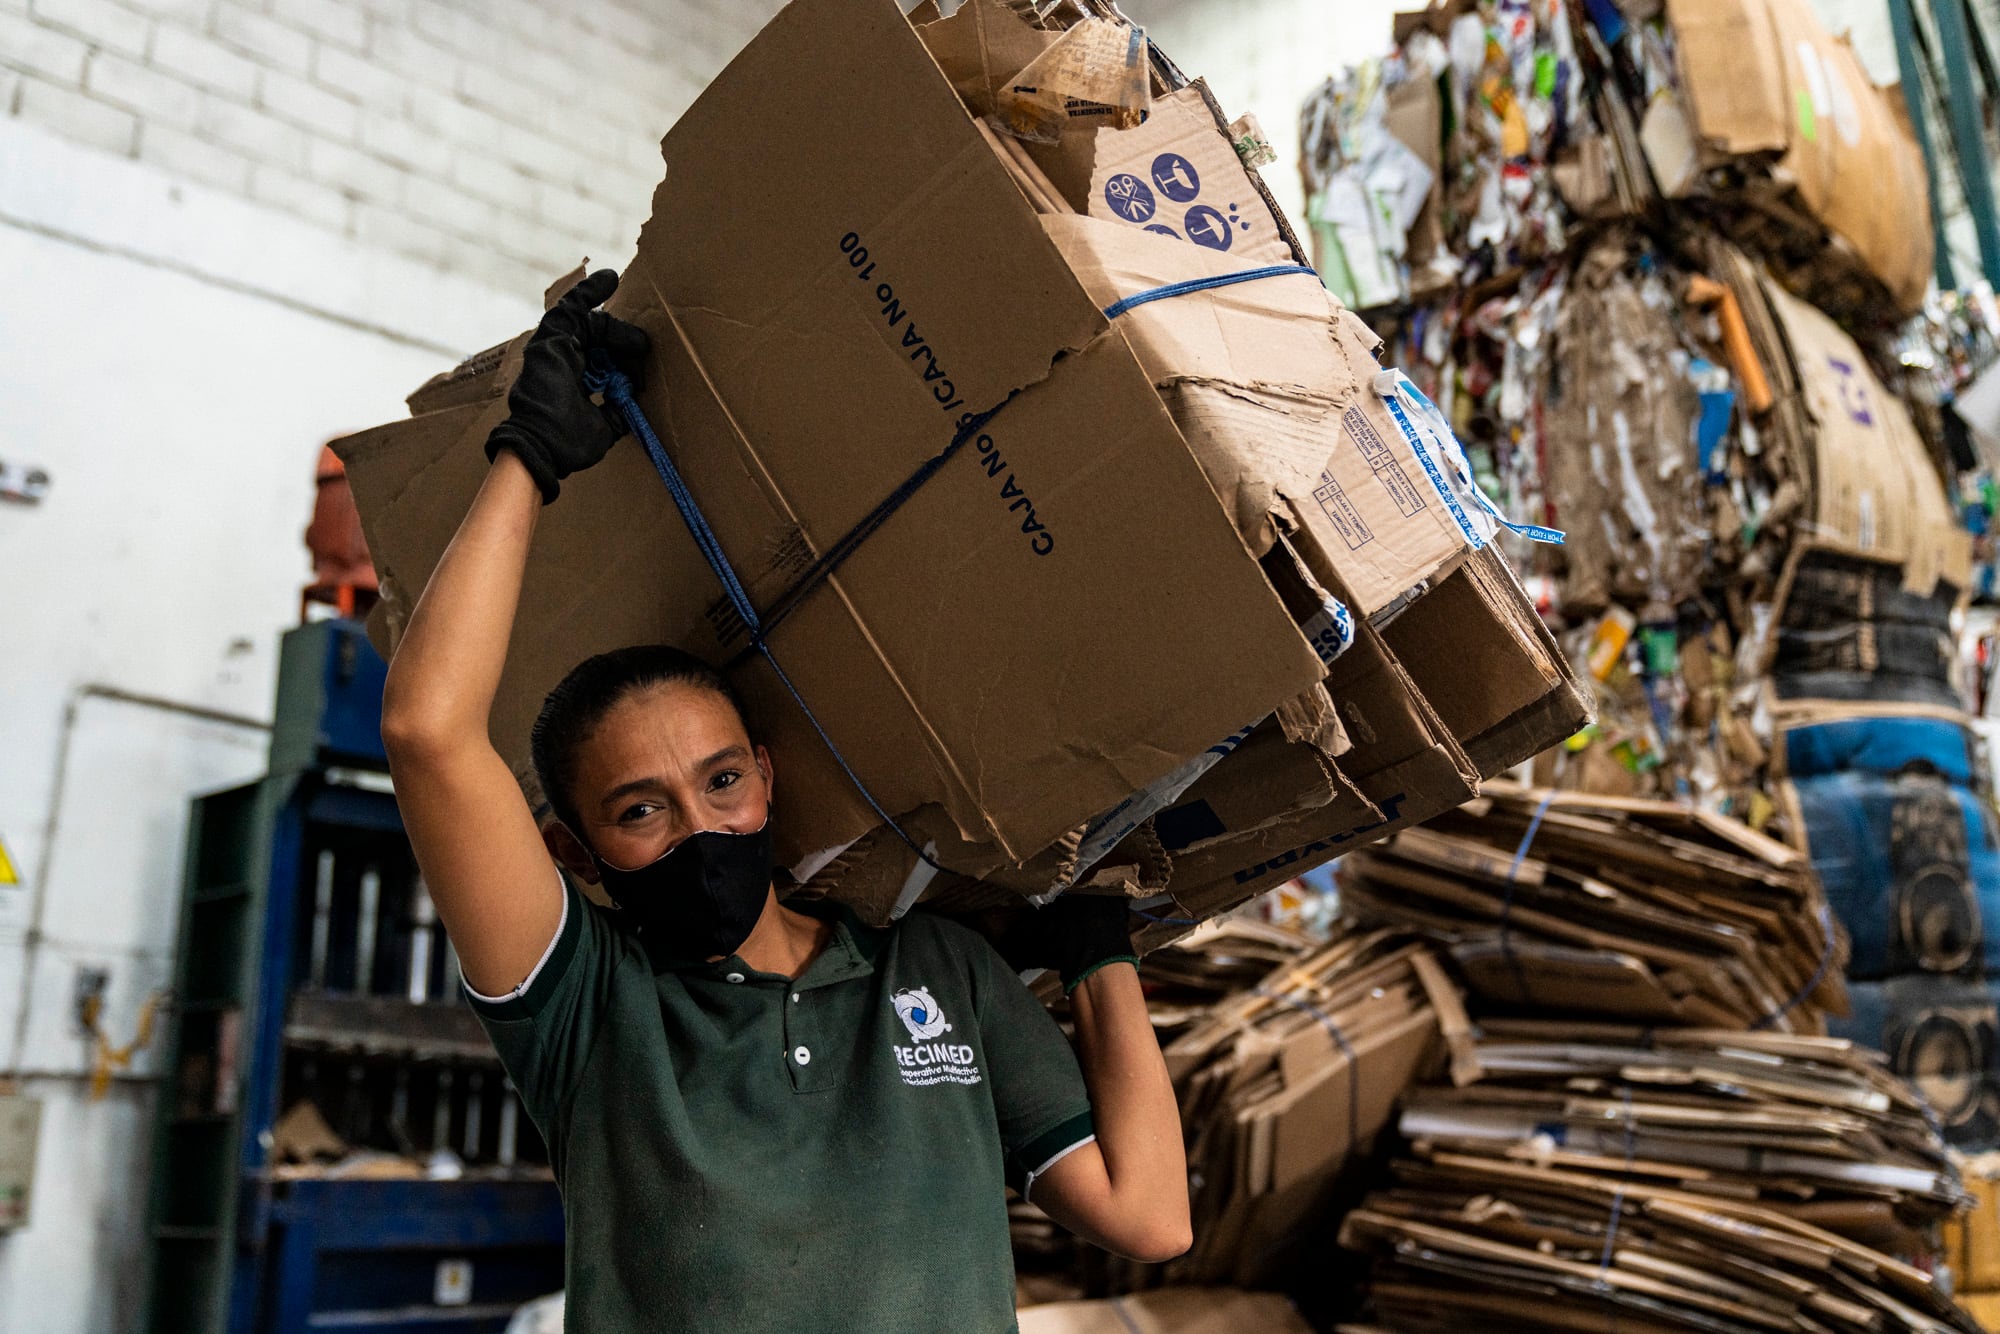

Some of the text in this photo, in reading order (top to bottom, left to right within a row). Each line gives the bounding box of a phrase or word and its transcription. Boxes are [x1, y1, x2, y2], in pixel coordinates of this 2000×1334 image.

[840, 231, 877, 281] 100
[876, 282, 907, 327] No
[1346, 410, 1354, 421] EN
[1366, 440, 1376, 450] DE
[976, 433, 1007, 478] No
[1000, 474, 1054, 556] CAJA
[1336, 494, 1350, 512] CAJAS
[1350, 516, 1368, 539] TENDIDO
[894, 1042, 974, 1066] RECIMED
